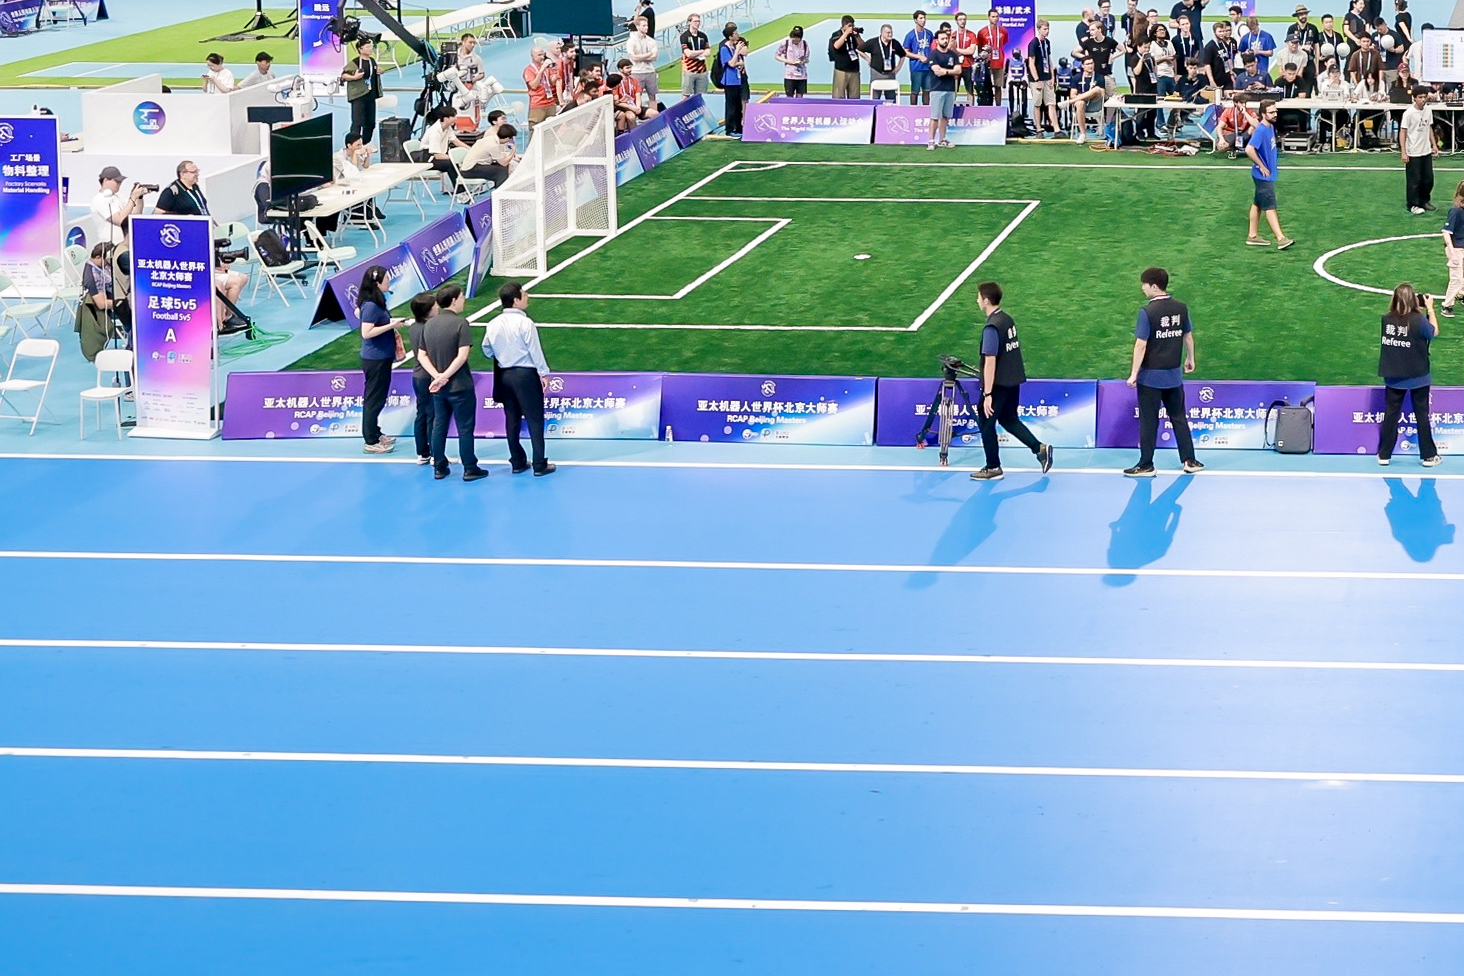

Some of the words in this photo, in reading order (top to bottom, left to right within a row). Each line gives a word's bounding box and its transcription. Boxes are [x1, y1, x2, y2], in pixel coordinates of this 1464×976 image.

[2, 165, 50, 177] 物料整理
[137, 259, 206, 272] 亚太机器人世界杯
[151, 271, 193, 282] 北京大师赛
[148, 295, 197, 310] 足球5v5
[152, 312, 178, 320] Football
[179, 313, 191, 321] 5v5
[1160, 314, 1181, 327] 裁判
[165, 328, 177, 342] A
[1156, 330, 1183, 339] Referee
[1386, 324, 1408, 337] 裁判
[1382, 336, 1411, 348] Referee
[263, 395, 411, 409] 亚太机器人世界杯北师赛
[697, 399, 839, 415] 亚太机器人世界杯北京大师赛
[294, 410, 317, 419] RCAP
[318, 410, 345, 419] Beijing
[563, 411, 594, 420] Masters
[727, 414, 748, 423] RCAP
[749, 415, 775, 424] Beijing
[776, 415, 807, 424] Masters
[1215, 422, 1246, 430] Masters
